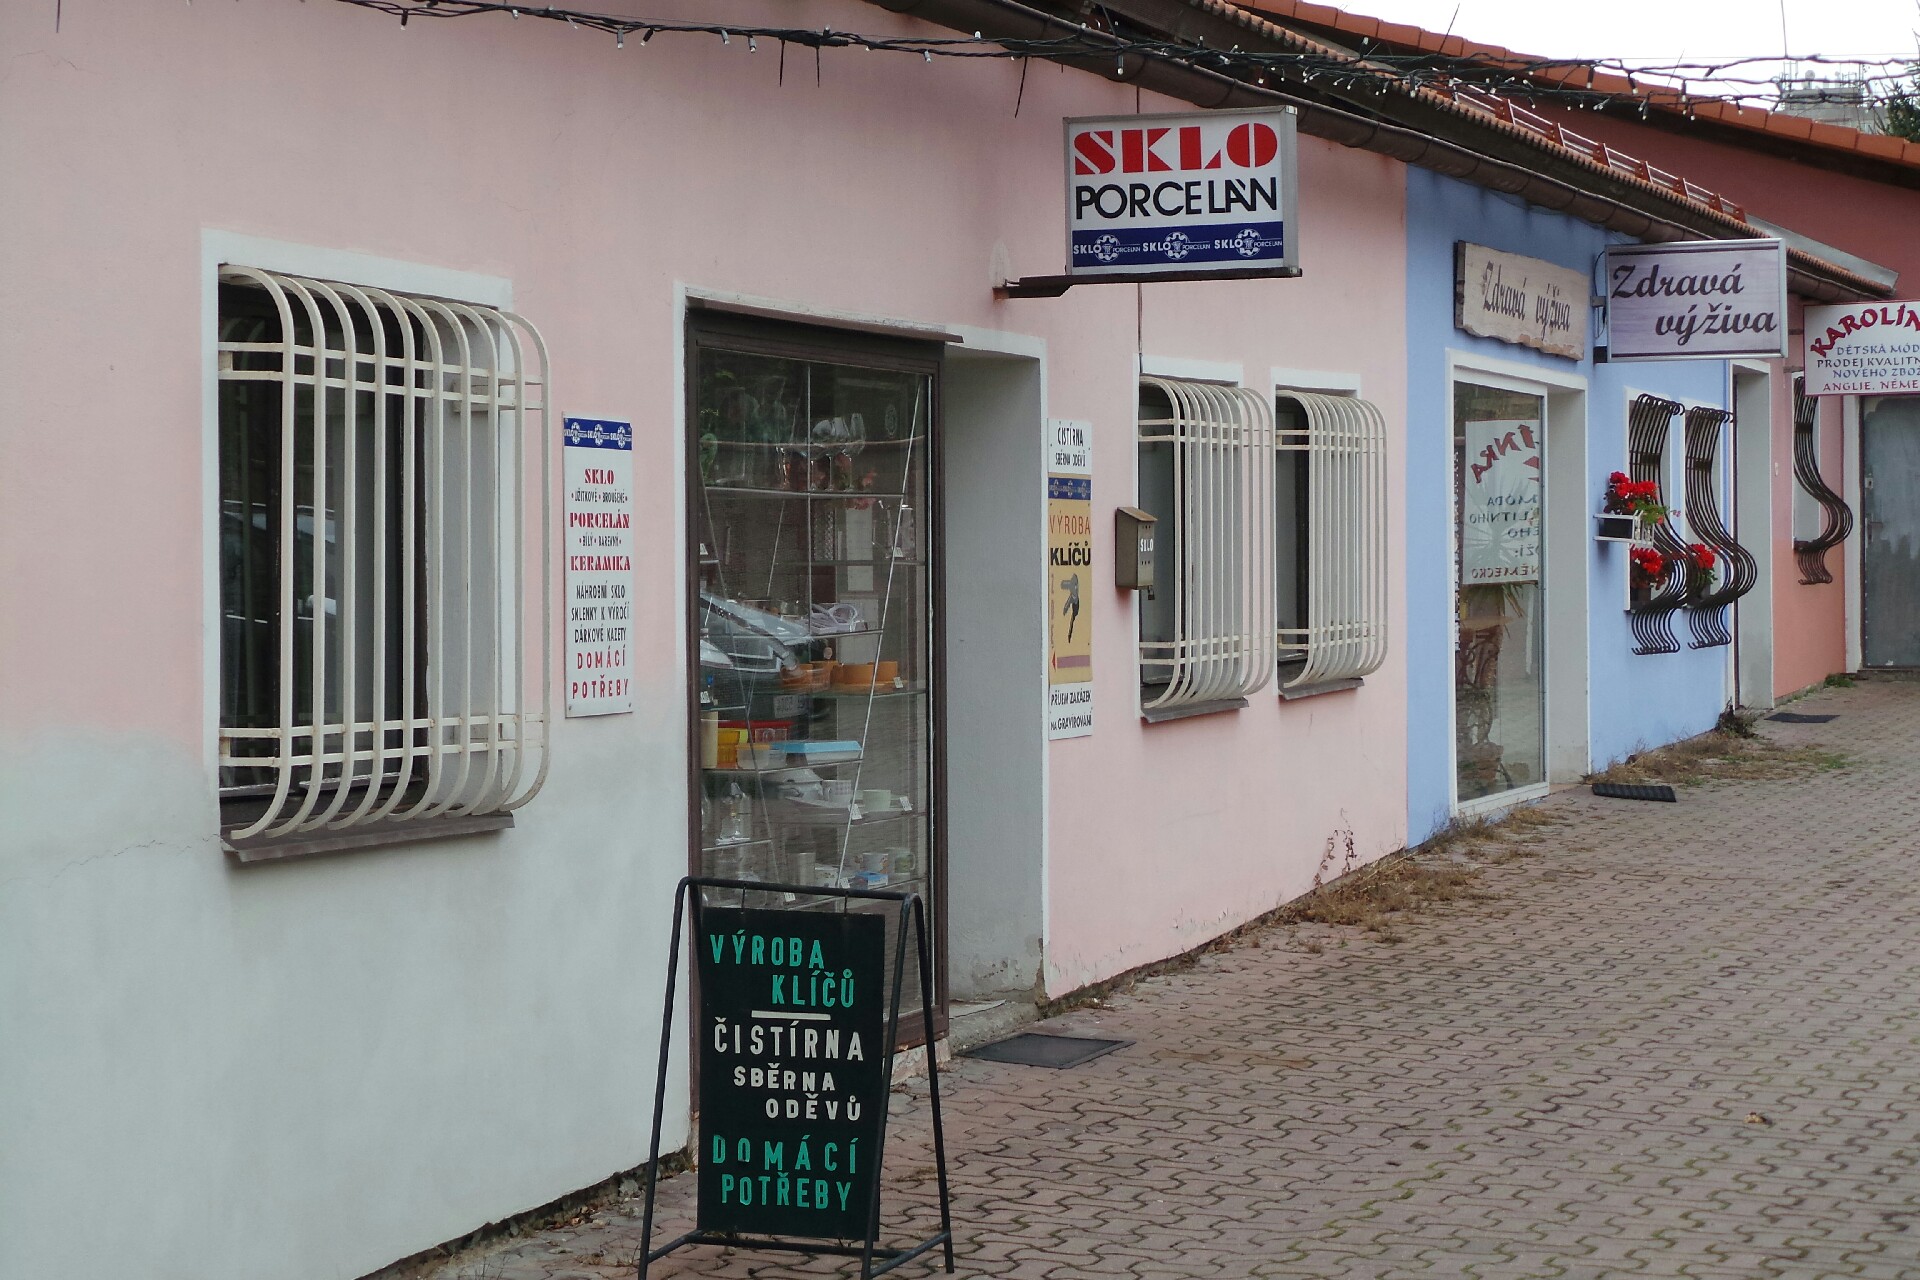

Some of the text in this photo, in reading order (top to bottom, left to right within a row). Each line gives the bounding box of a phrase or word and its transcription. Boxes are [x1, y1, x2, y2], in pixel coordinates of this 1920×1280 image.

[1074, 123, 1277, 175] SKLO
[1073, 244, 1101, 254] SKLO
[1142, 241, 1171, 252] SKLO
[1214, 239, 1243, 249] SKLO
[1612, 263, 1744, 299] Zdravá
[1483, 260, 1571, 341] Zdravá výživa
[1655, 302, 1777, 346] výživa
[1817, 358, 1863, 368] PRODEJ
[1837, 344, 1887, 356] DĚTSKÁ
[1057, 420, 1084, 447] ČISTÍRNA
[584, 468, 614, 484] SKLO
[570, 508, 630, 529] PORCELÁN
[1049, 510, 1091, 536] VÝROBA
[570, 555, 631, 571] KERAMIKA
[1050, 540, 1091, 566] KLÍČŮ
[576, 580, 626, 599] NÁHROBNÍ SKLO
[571, 601, 630, 621] SKLENKY K VÝROČÍ
[574, 623, 627, 643] DÁRKOVÉ KAZETY
[577, 644, 626, 670] DOMÁCÍ
[572, 674, 629, 700] POTŘEBY
[710, 929, 824, 969] VÝROBA
[772, 968, 855, 1008] KLÍČŮ
[714, 1016, 864, 1061] ČISTÍRNA
[733, 1062, 835, 1092] SBĚRNA
[765, 1093, 861, 1121] ODĚVŮ
[712, 1134, 859, 1174] DOMÁCÍ
[721, 1171, 851, 1212] POTŘEBY
